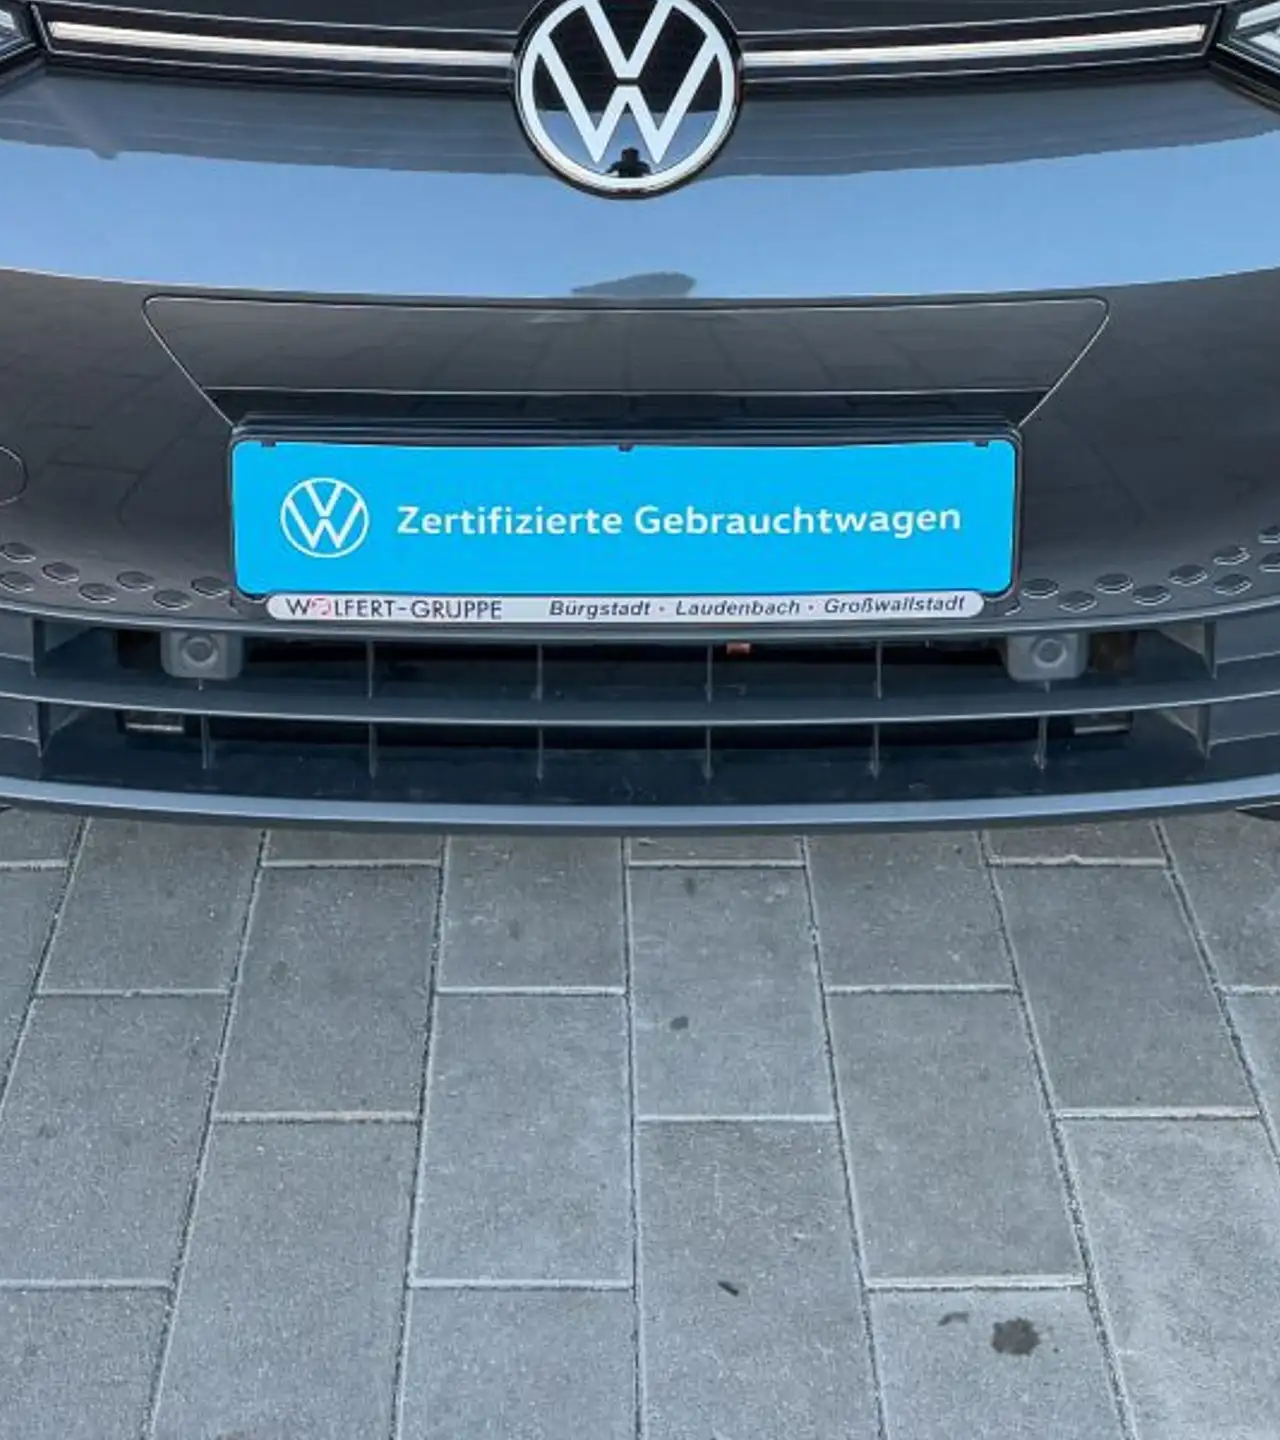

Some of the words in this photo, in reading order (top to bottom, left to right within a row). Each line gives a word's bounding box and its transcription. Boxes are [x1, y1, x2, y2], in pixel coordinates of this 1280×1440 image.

[396, 505, 623, 535] Zertifizierte
[634, 504, 962, 540] Gebrauchtwagen
[549, 599, 651, 621] Bürgstadt
[675, 598, 801, 617] Laudenbach
[823, 594, 966, 615] Großwallstadt
